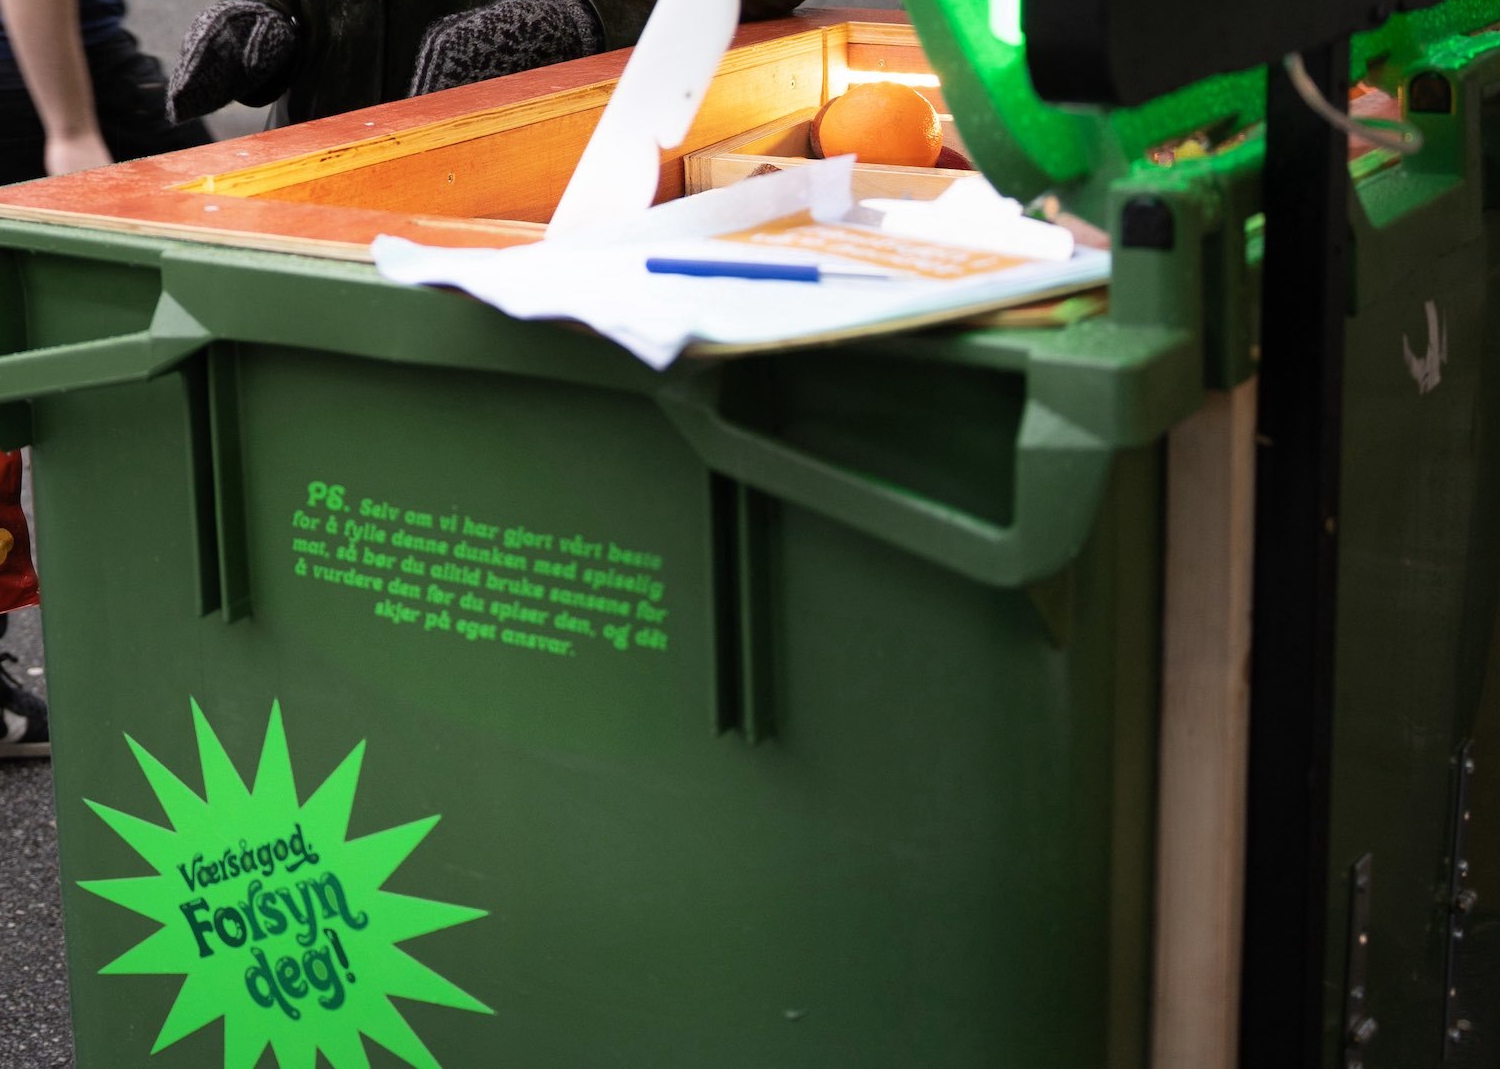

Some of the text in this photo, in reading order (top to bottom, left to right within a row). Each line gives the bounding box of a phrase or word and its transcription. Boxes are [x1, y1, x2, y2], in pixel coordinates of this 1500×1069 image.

[293, 509, 321, 531] for
[325, 514, 338, 535] å
[344, 519, 387, 545] fylle
[391, 529, 449, 556] denne
[453, 541, 528, 571] dunken
[533, 559, 578, 580] med
[307, 481, 350, 513] PS.
[359, 498, 400, 521] Selv
[404, 510, 433, 529] om
[439, 514, 459, 534] vi
[463, 516, 499, 539] har
[313, 564, 385, 592] vurdere
[388, 576, 422, 599] den
[459, 591, 485, 613] du
[602, 623, 632, 651] og
[400, 555, 426, 576] du
[429, 562, 482, 587] alltid
[485, 570, 545, 600] bruke
[424, 609, 451, 631] på
[179, 871, 369, 958] Forsyn
[244, 928, 356, 1021] deg!
